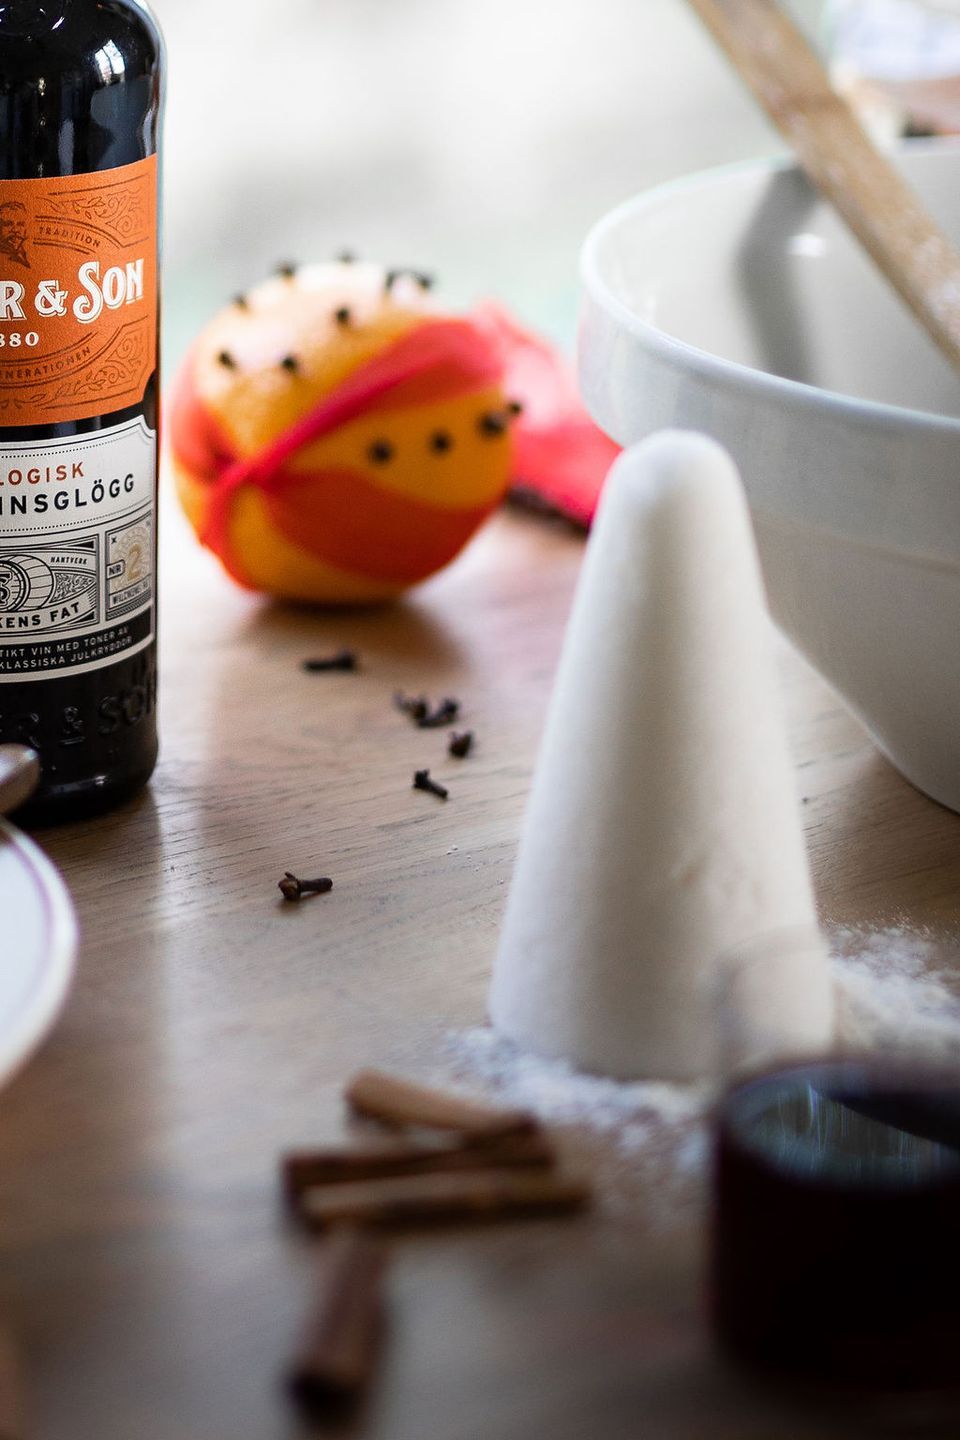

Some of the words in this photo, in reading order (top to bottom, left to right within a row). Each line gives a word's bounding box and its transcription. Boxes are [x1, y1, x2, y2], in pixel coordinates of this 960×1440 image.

[40, 226, 101, 248] TRADITION
[34, 279, 68, 318] &
[73, 258, 145, 324] SON
[127, 543, 142, 582] 2
[50, 601, 81, 623] FAT
[31, 646, 51, 656] VIN
[56, 641, 80, 652] MED
[84, 631, 116, 647] TONER
